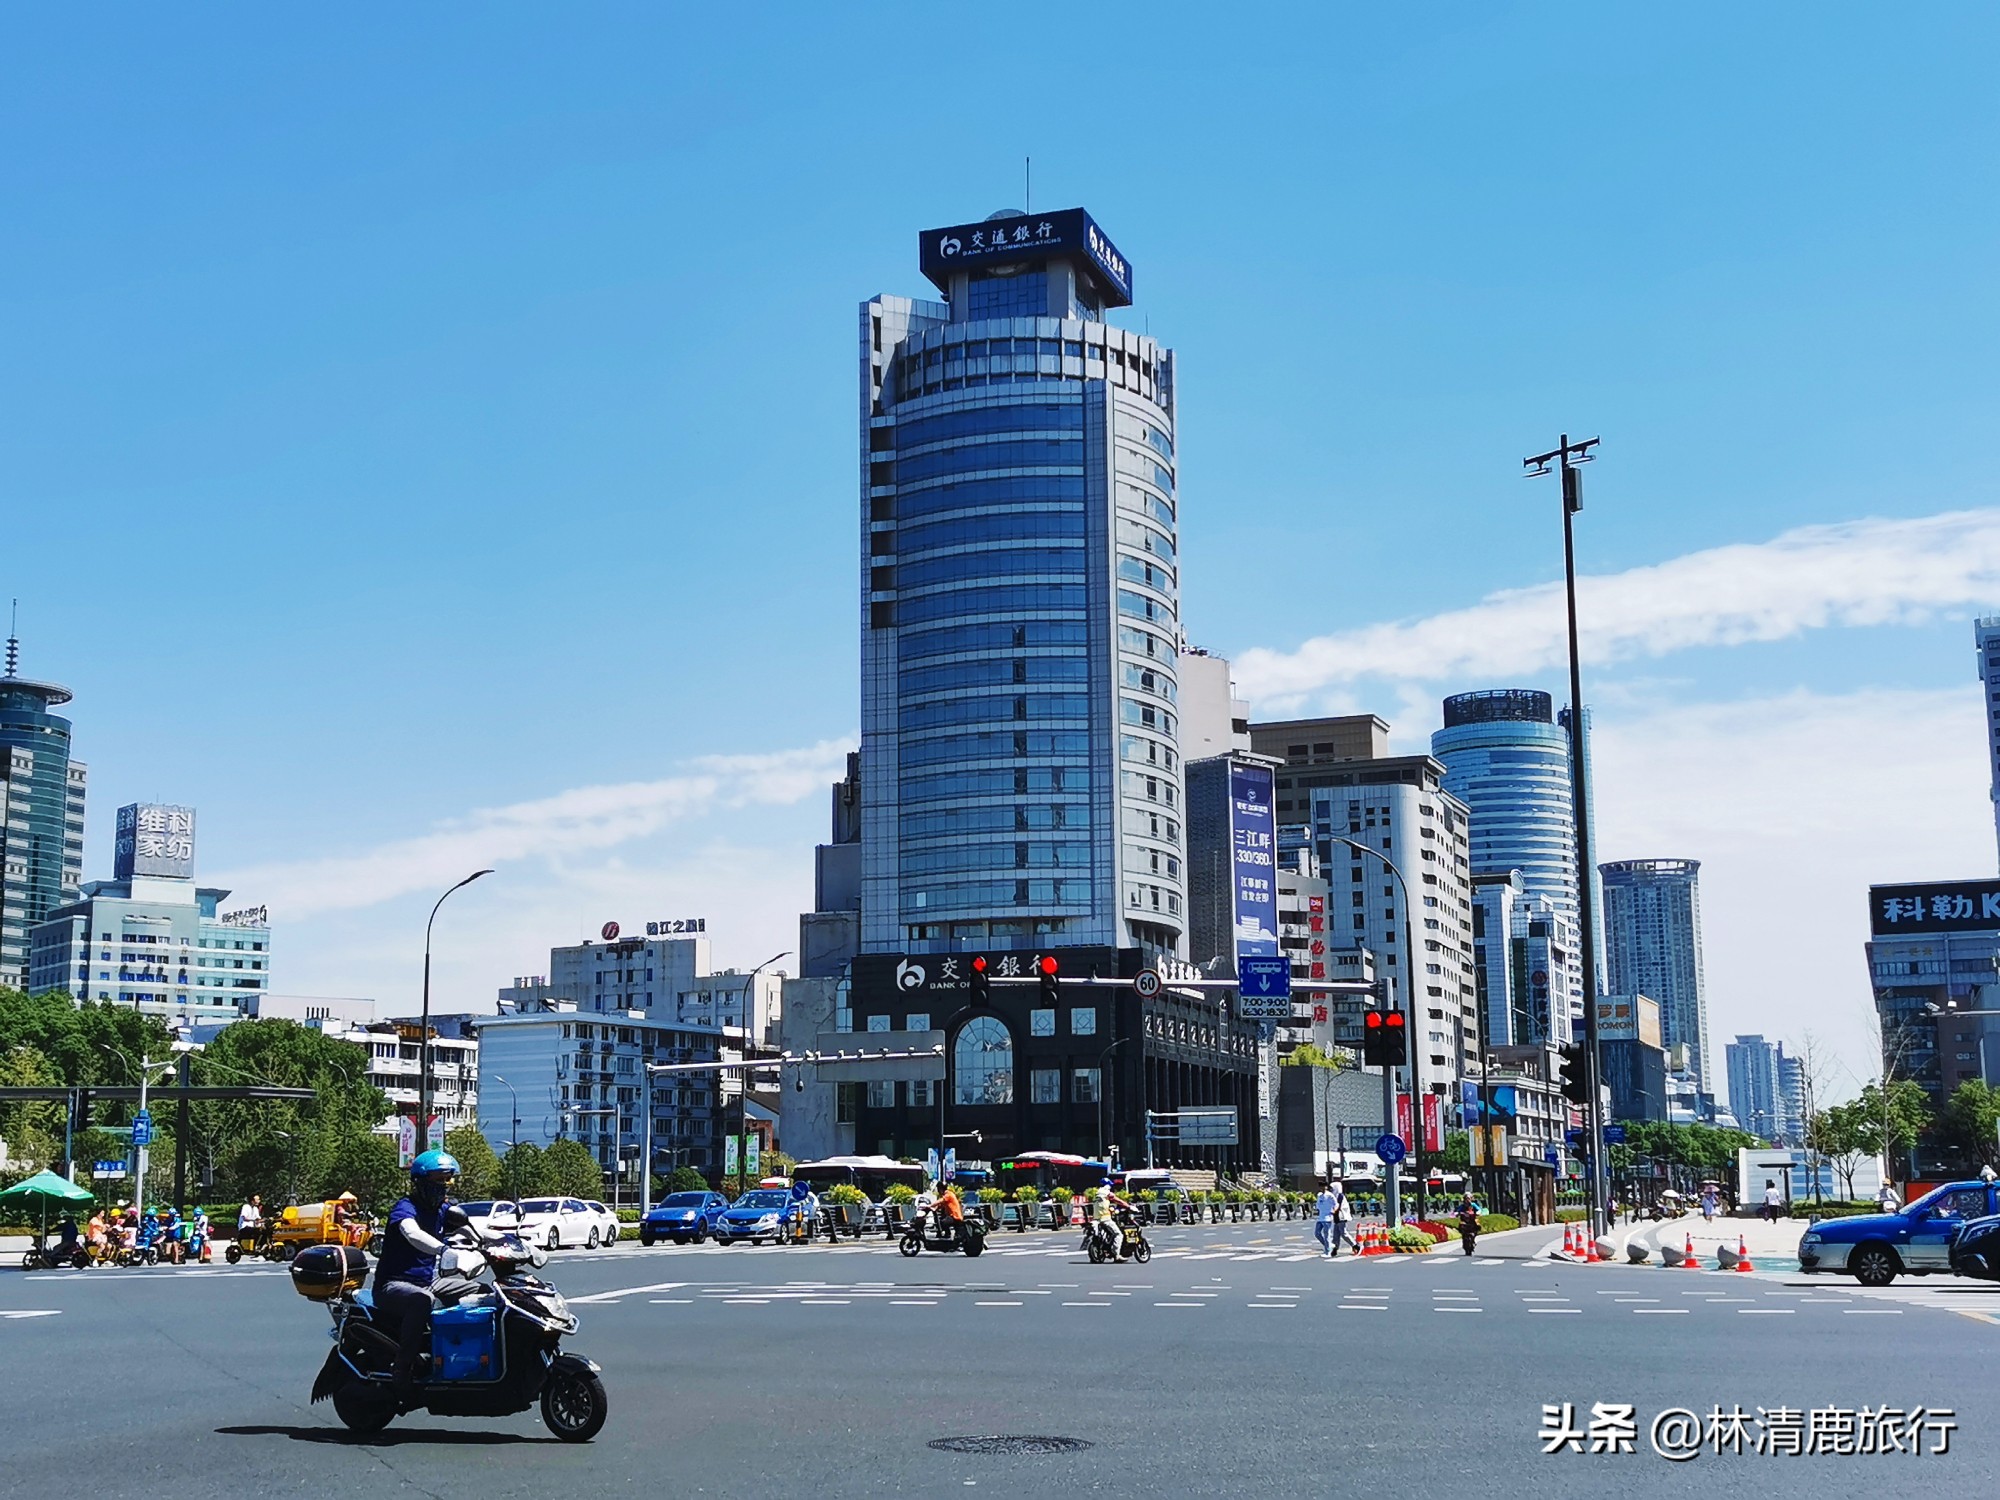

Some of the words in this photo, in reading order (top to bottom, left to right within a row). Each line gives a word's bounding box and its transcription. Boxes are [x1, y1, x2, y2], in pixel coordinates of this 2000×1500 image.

[970, 221, 1054, 248] 交通銀行
[962, 249, 982, 257] BANK
[138, 808, 193, 836] 维科
[137, 834, 193, 860] 家纺
[1882, 894, 1974, 922] 科勒
[940, 954, 1041, 980] 交銀
[929, 982, 956, 990] BANK
[1140, 976, 1155, 991] 60
